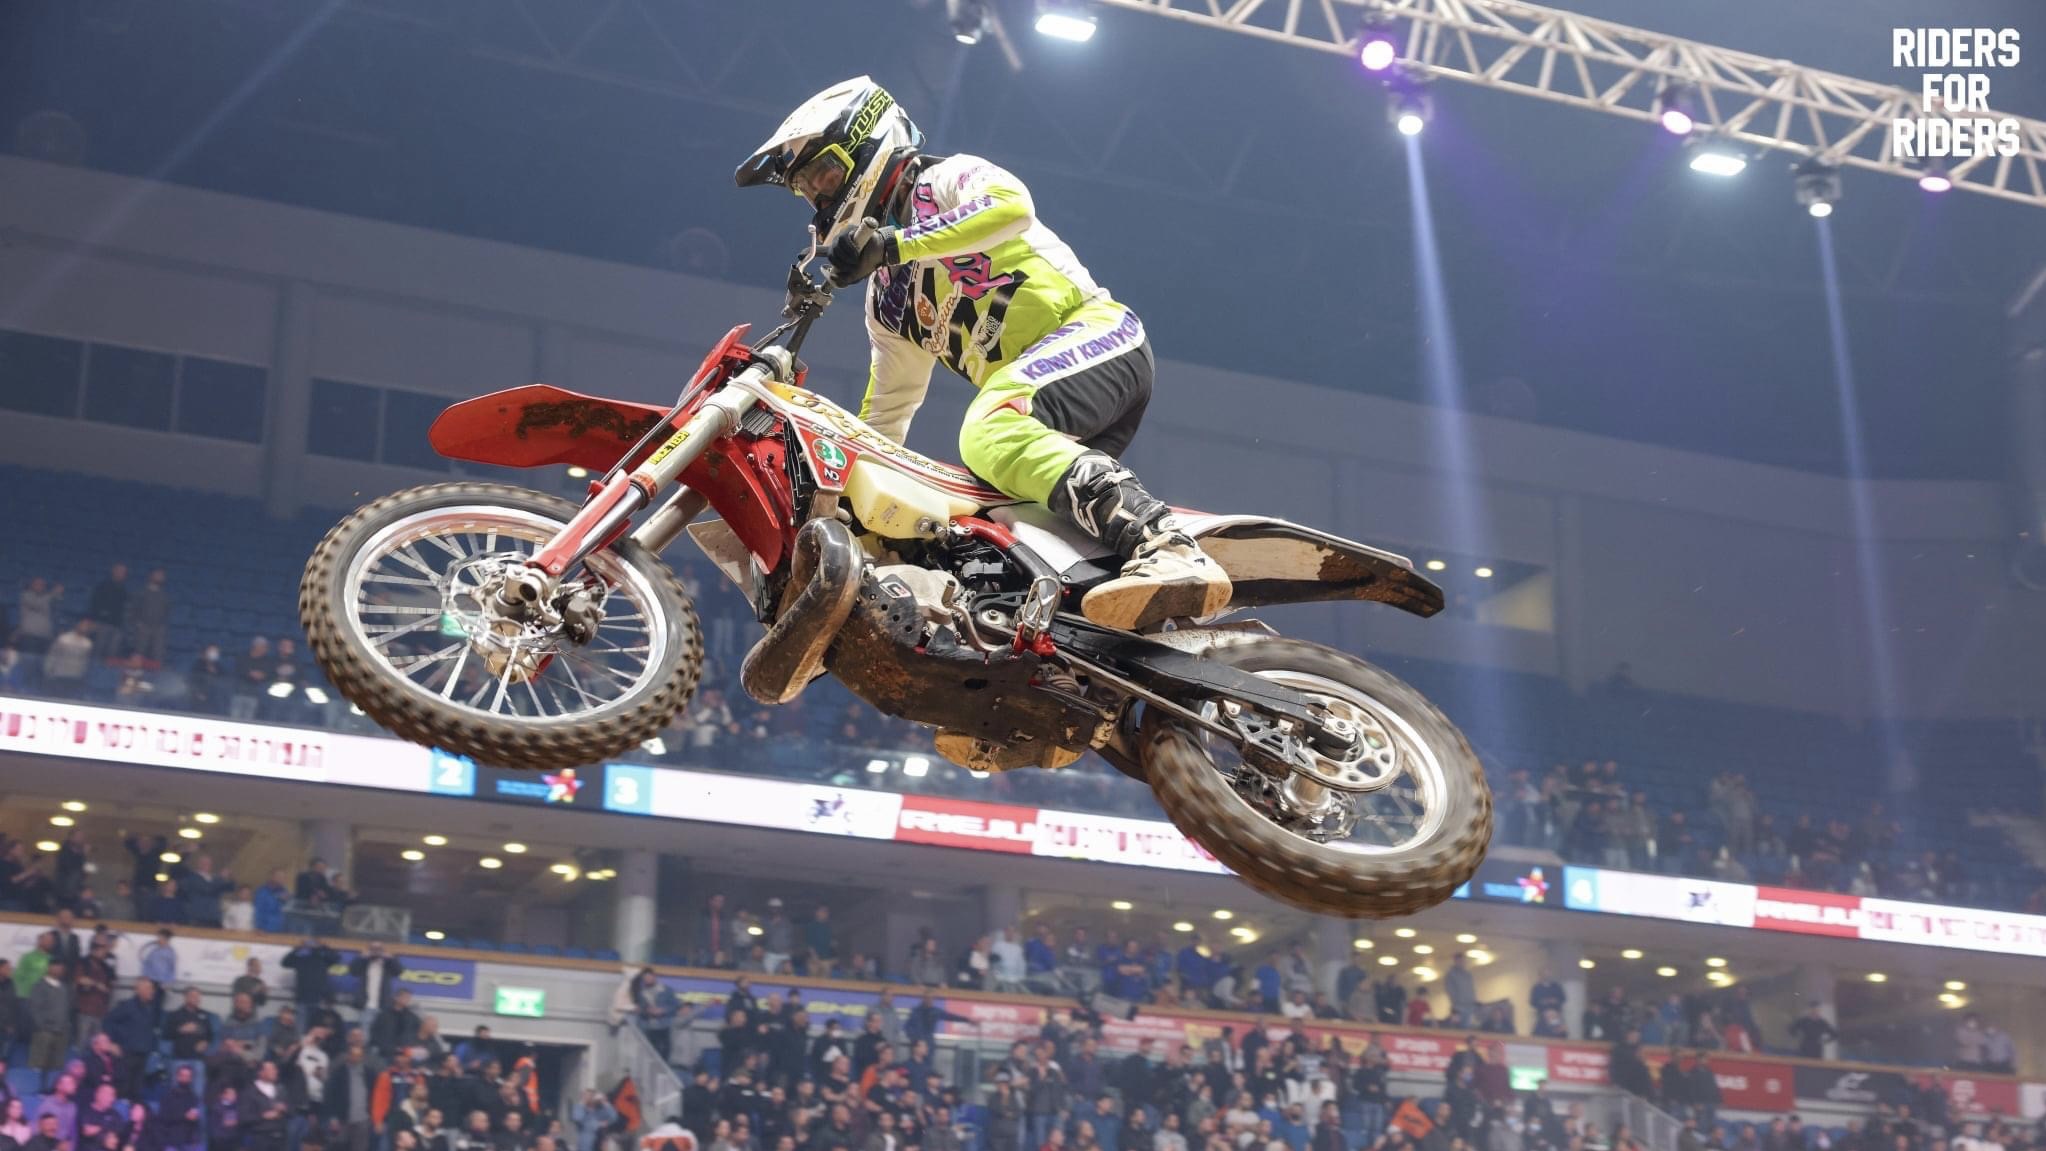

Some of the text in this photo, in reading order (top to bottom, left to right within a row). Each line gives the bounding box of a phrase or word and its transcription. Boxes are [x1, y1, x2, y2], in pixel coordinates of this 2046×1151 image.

[1021, 348, 1079, 380] KENNY
[1077, 328, 1122, 361] KENNY
[438, 758, 463, 786] 2
[614, 777, 639, 805] 3
